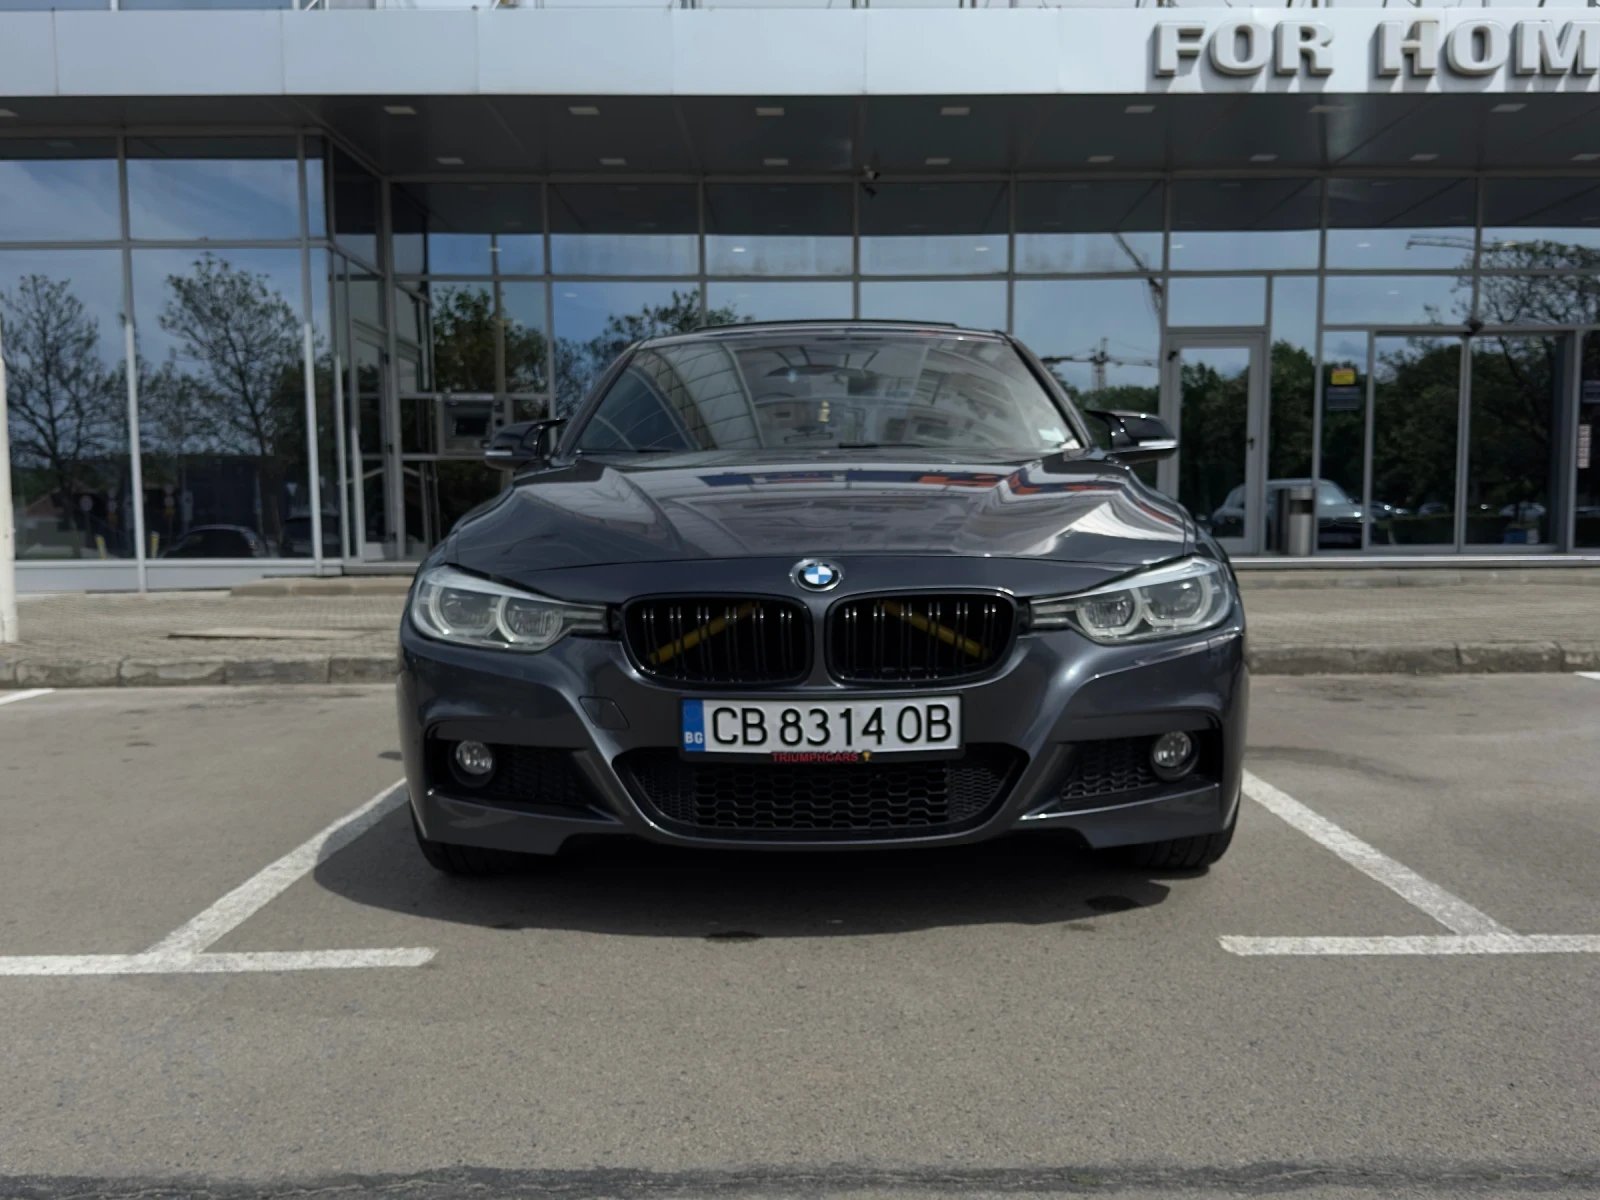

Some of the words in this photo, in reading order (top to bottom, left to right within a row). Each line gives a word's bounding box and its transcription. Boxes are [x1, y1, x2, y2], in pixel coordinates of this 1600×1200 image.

[1154, 20, 1334, 76] FOR
[1376, 20, 1600, 76] HOM
[684, 731, 703, 744] BG
[712, 707, 768, 746] CB
[779, 707, 885, 747] 8314
[897, 704, 952, 743] OB
[772, 752, 858, 763] TRIUMPHCARS
